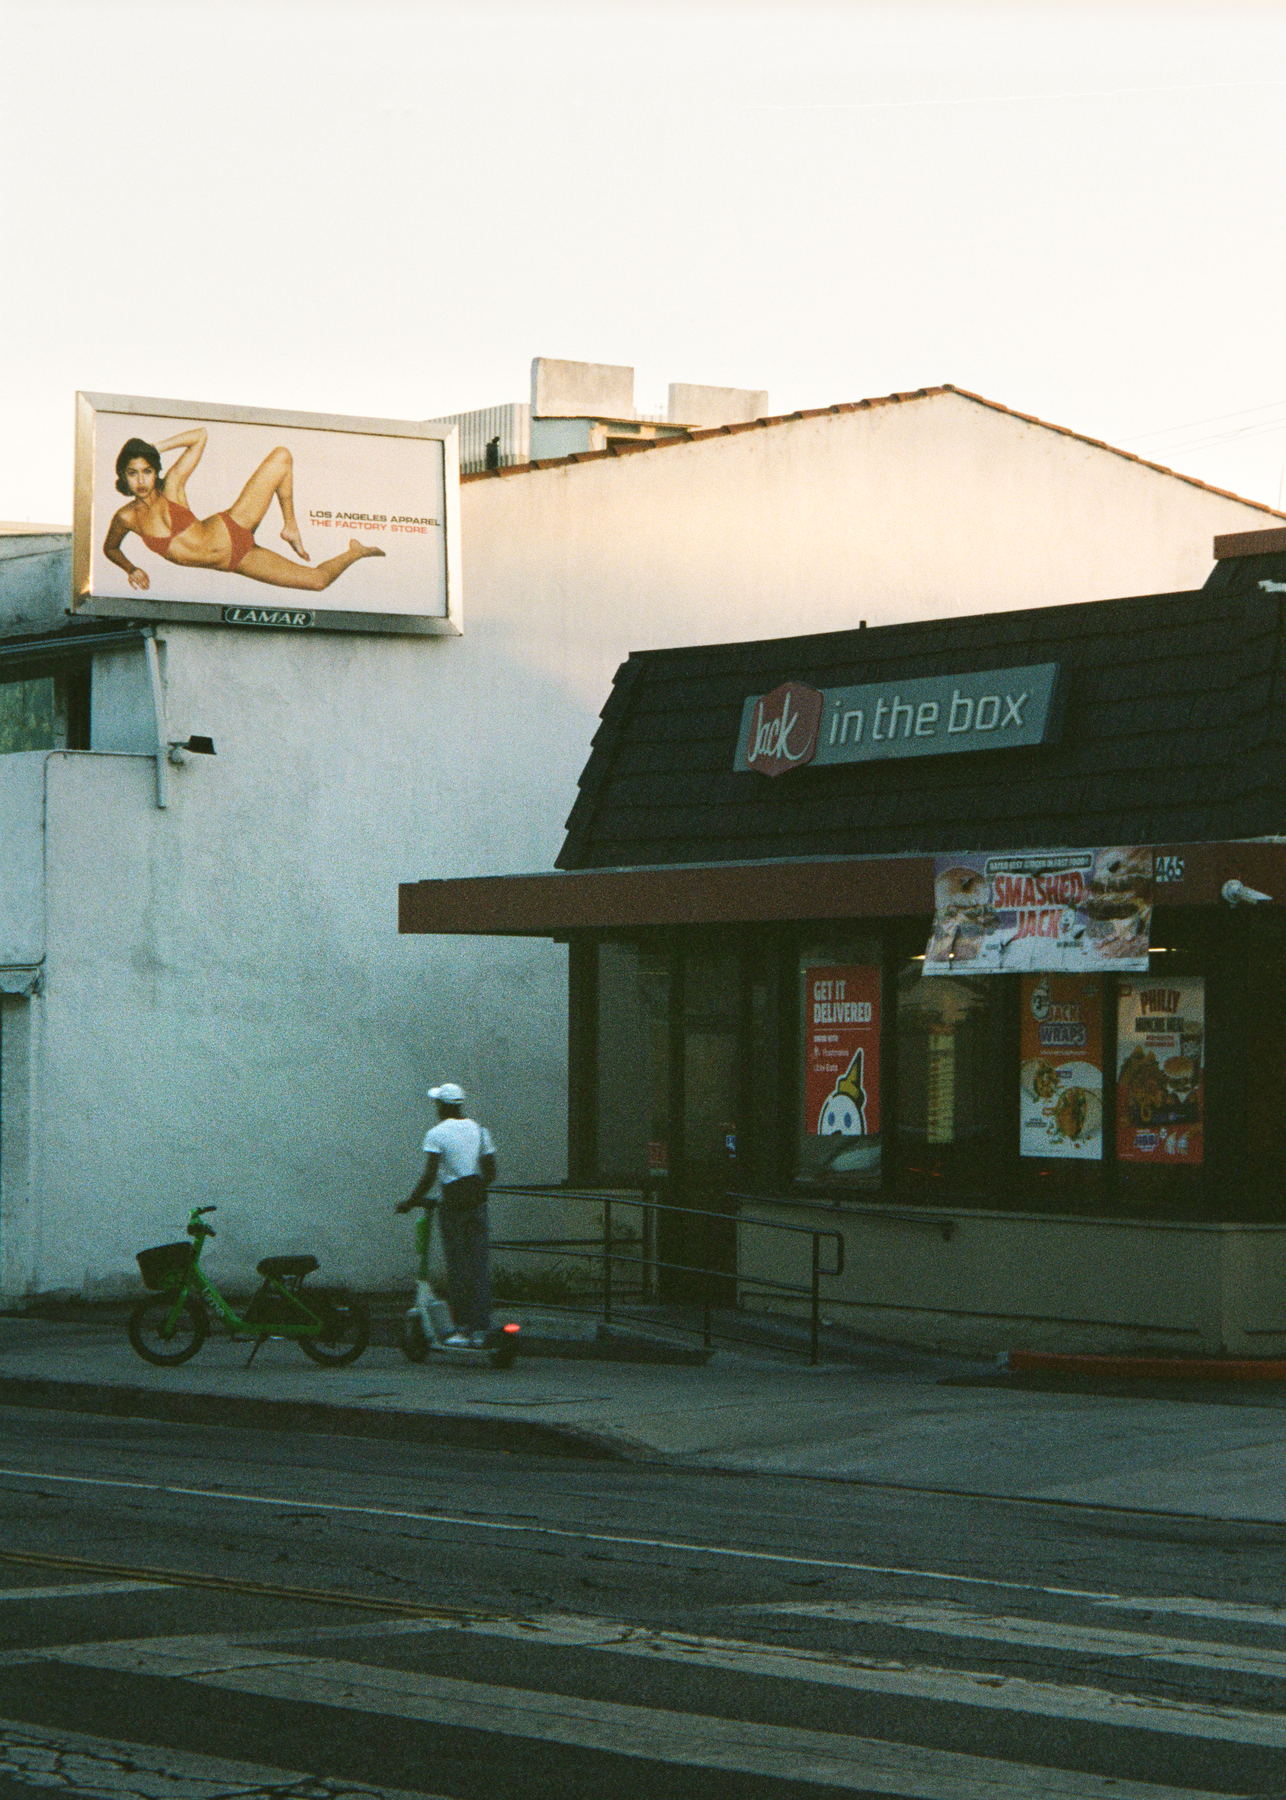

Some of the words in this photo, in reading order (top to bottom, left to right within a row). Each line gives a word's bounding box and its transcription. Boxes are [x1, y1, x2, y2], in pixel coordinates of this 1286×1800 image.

[310, 510, 332, 519] LOS
[337, 512, 387, 522] ANGELES
[390, 515, 440, 526] APPAREL
[310, 519, 332, 528] THE
[335, 520, 387, 532] FACTORY
[391, 525, 428, 534] STORE
[233, 609, 306, 625] LAMAR
[747, 691, 814, 763] Jack
[829, 700, 864, 745] in
[872, 694, 940, 740] the
[947, 689, 1029, 734] box
[994, 871, 1083, 908] SMASHED
[1011, 909, 1059, 939] JACK
[814, 982, 832, 1001] GET
[835, 981, 846, 1000] IT
[813, 1002, 872, 1023] DELIVERED
